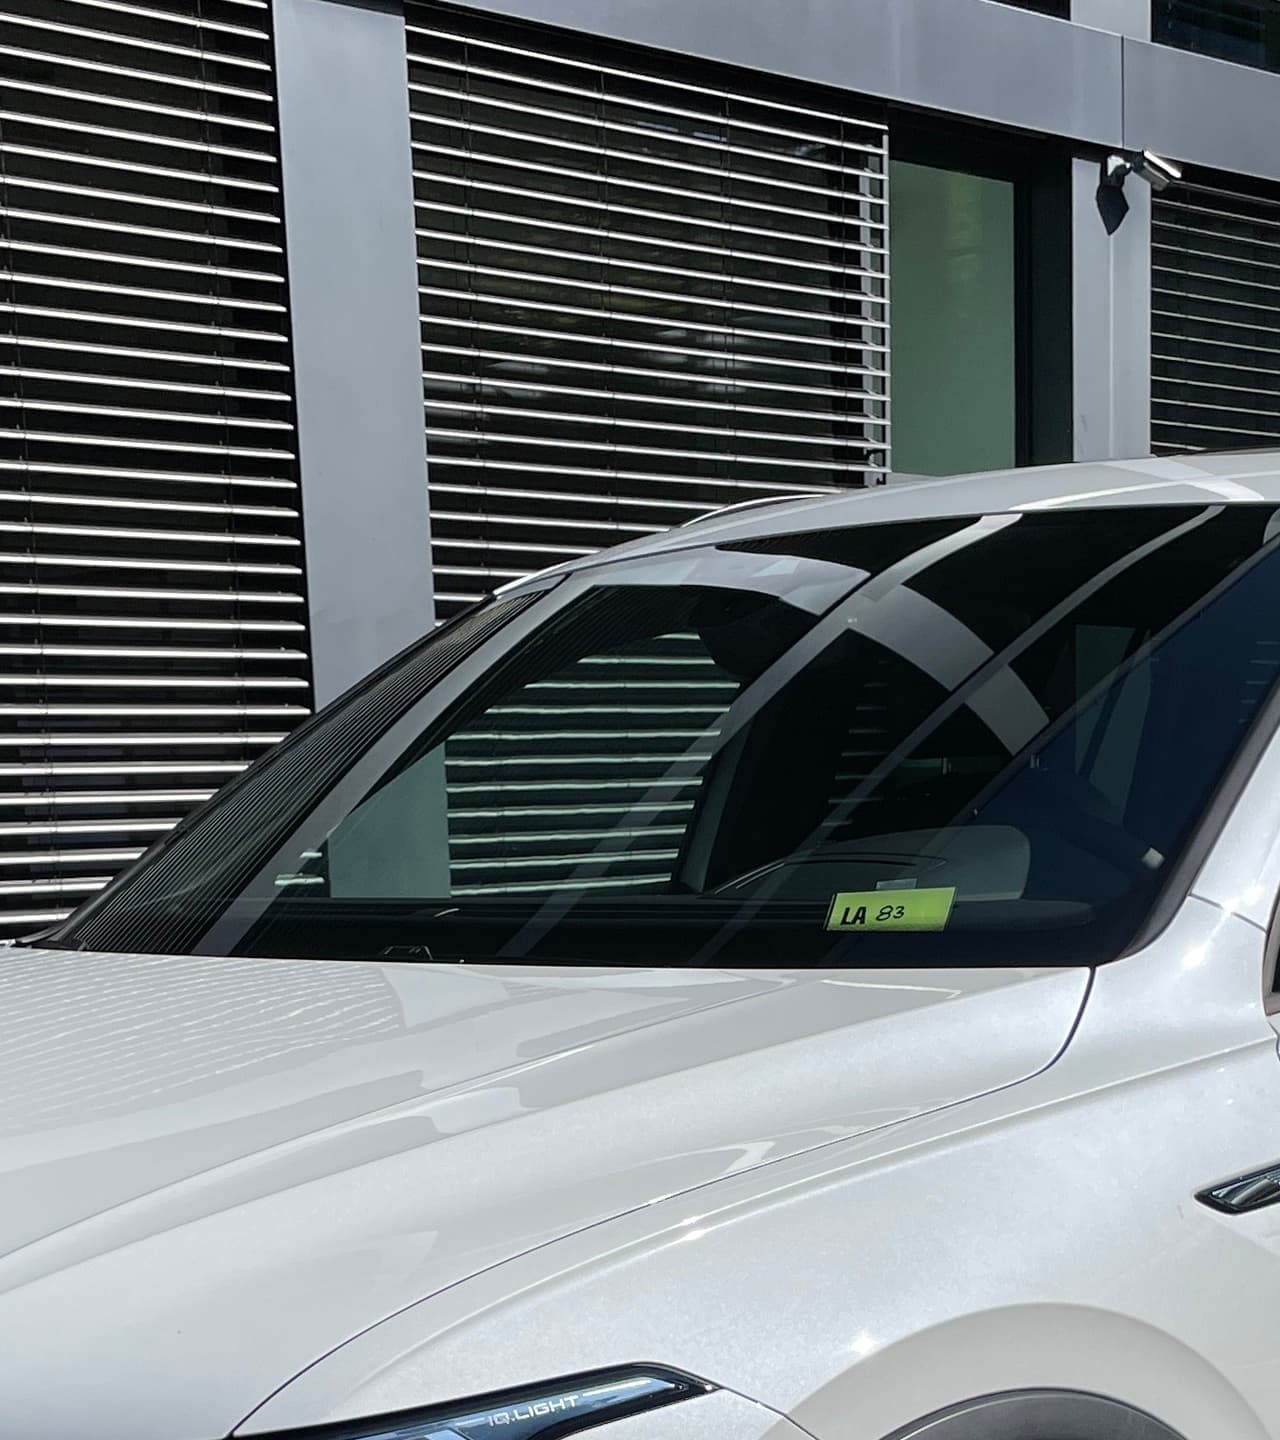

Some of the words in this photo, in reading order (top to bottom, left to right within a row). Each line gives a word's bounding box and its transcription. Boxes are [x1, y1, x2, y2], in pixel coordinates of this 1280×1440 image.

[840, 906, 867, 926] LA
[875, 904, 905, 922] 83
[487, 1395, 580, 1427] IQ.LIGHT
